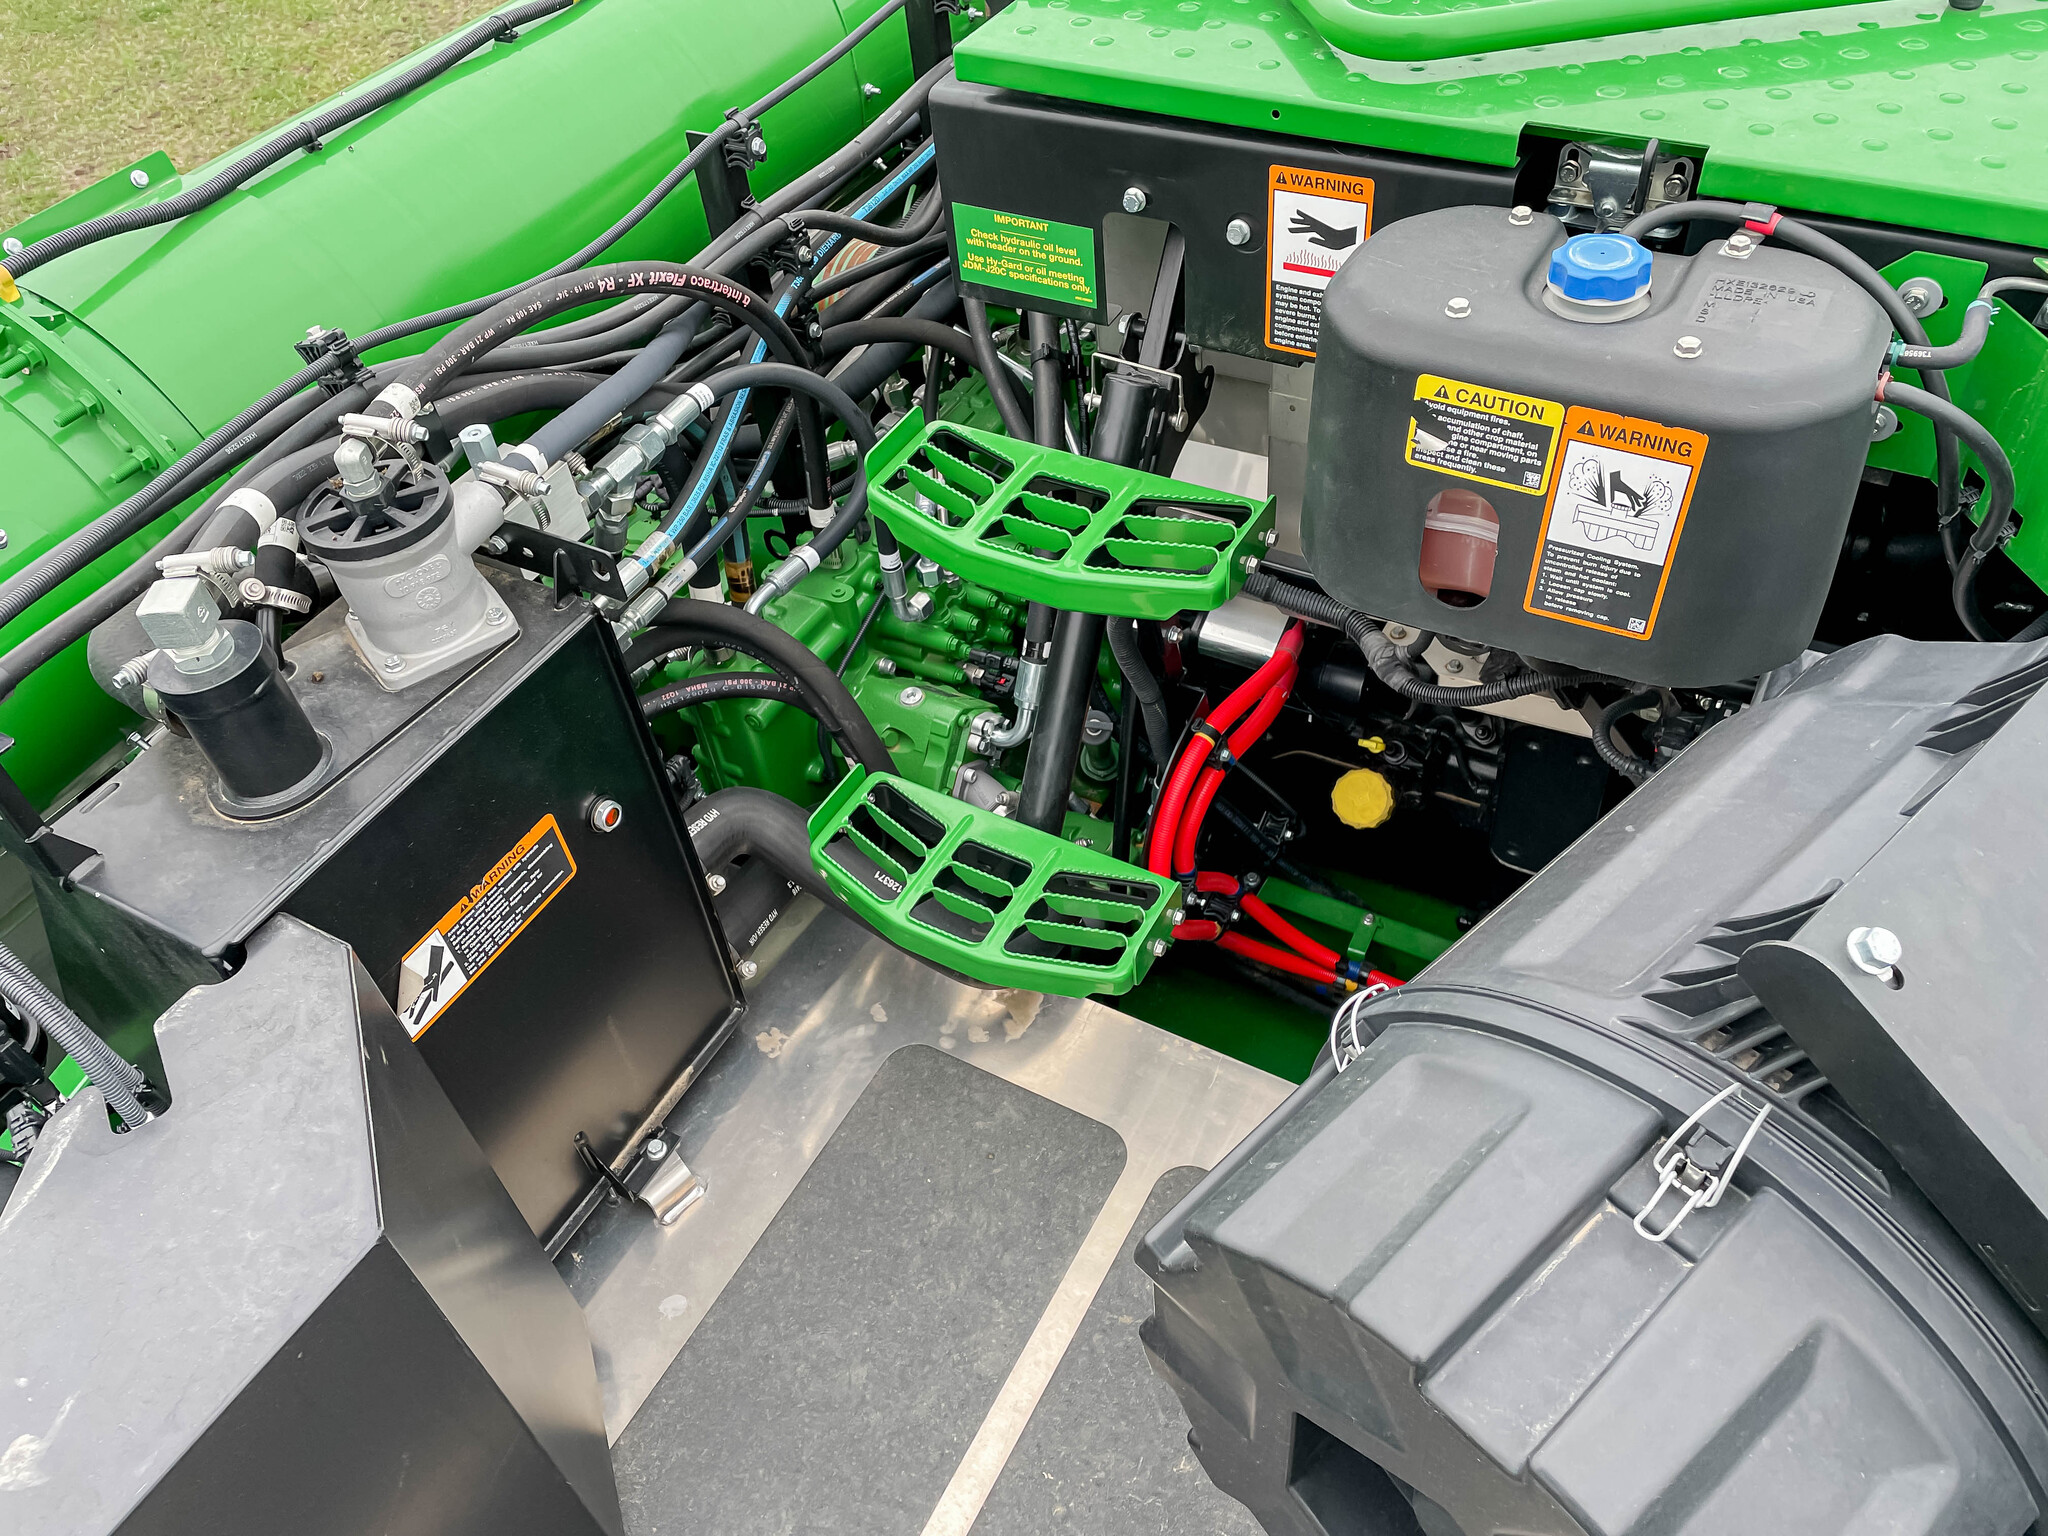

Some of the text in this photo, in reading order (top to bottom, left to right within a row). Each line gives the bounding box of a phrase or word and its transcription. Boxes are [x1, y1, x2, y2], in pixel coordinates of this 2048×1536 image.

[1290, 173, 1364, 195] WARNING
[994, 214, 1049, 232] IMPORTANT
[971, 229, 1077, 256] Check hydraulic oil level
[966, 238, 984, 247] with
[986, 241, 1016, 253] header
[1032, 250, 1047, 259] the
[1049, 254, 1083, 267] ground.
[962, 260, 1092, 294] JDM-J20C specifications only.
[967, 252, 984, 262] Use
[986, 256, 1022, 271] Hy-Gard
[1036, 267, 1047, 276] oil
[1049, 271, 1085, 284] meeting
[597, 275, 615, 293] R4
[627, 272, 644, 287] XF
[649, 271, 687, 287] Flexit
[690, 275, 743, 303] intertraco
[1275, 284, 1298, 293] Engine
[1275, 293, 1298, 301] system
[1712, 285, 1754, 295] MADE
[1788, 296, 1816, 307] USA
[1275, 308, 1296, 316] severe
[1275, 315, 1296, 323] engine
[1274, 323, 1313, 335] components
[1274, 329, 1294, 338] before
[460, 340, 475, 356] BAR
[1274, 338, 1295, 346] engine
[434, 361, 447, 377] PSI
[1456, 388, 1545, 420] CAUTION
[1447, 406, 1493, 422] equipment
[1490, 416, 1511, 426] fires.
[1437, 416, 1525, 441] accumulation of chaff,
[1463, 427, 1484, 438] other
[1485, 433, 1504, 444] crop
[1505, 436, 1539, 450] material
[1471, 437, 1525, 456] compartment,
[1526, 449, 1537, 457] on
[1600, 424, 1693, 458] WARNING
[1445, 453, 1460, 462] and
[1461, 456, 1482, 467] clean
[1484, 461, 1506, 473] these
[1463, 449, 1479, 460] fire.
[1469, 444, 1488, 455] near
[1489, 449, 1519, 463] moving
[1520, 457, 1542, 467] parts
[1414, 454, 1477, 474] areas frequently.
[1548, 544, 1639, 570] Pressurized Cooling System.
[1557, 554, 1580, 564] prevent
[1600, 564, 1618, 573] injury
[1545, 559, 1583, 572] uncontrolled
[1586, 568, 1608, 577] release
[1547, 588, 1564, 596] Allow
[1566, 592, 1593, 603] pressure
[1548, 581, 1571, 590] Loosen
[1574, 587, 1585, 595] cap
[1582, 582, 1604, 592] system
[1544, 601, 1563, 610] before
[1565, 606, 1594, 618] removing
[1555, 597, 1577, 606] release
[704, 808, 721, 821] HYD
[767, 908, 779, 923] HYD
